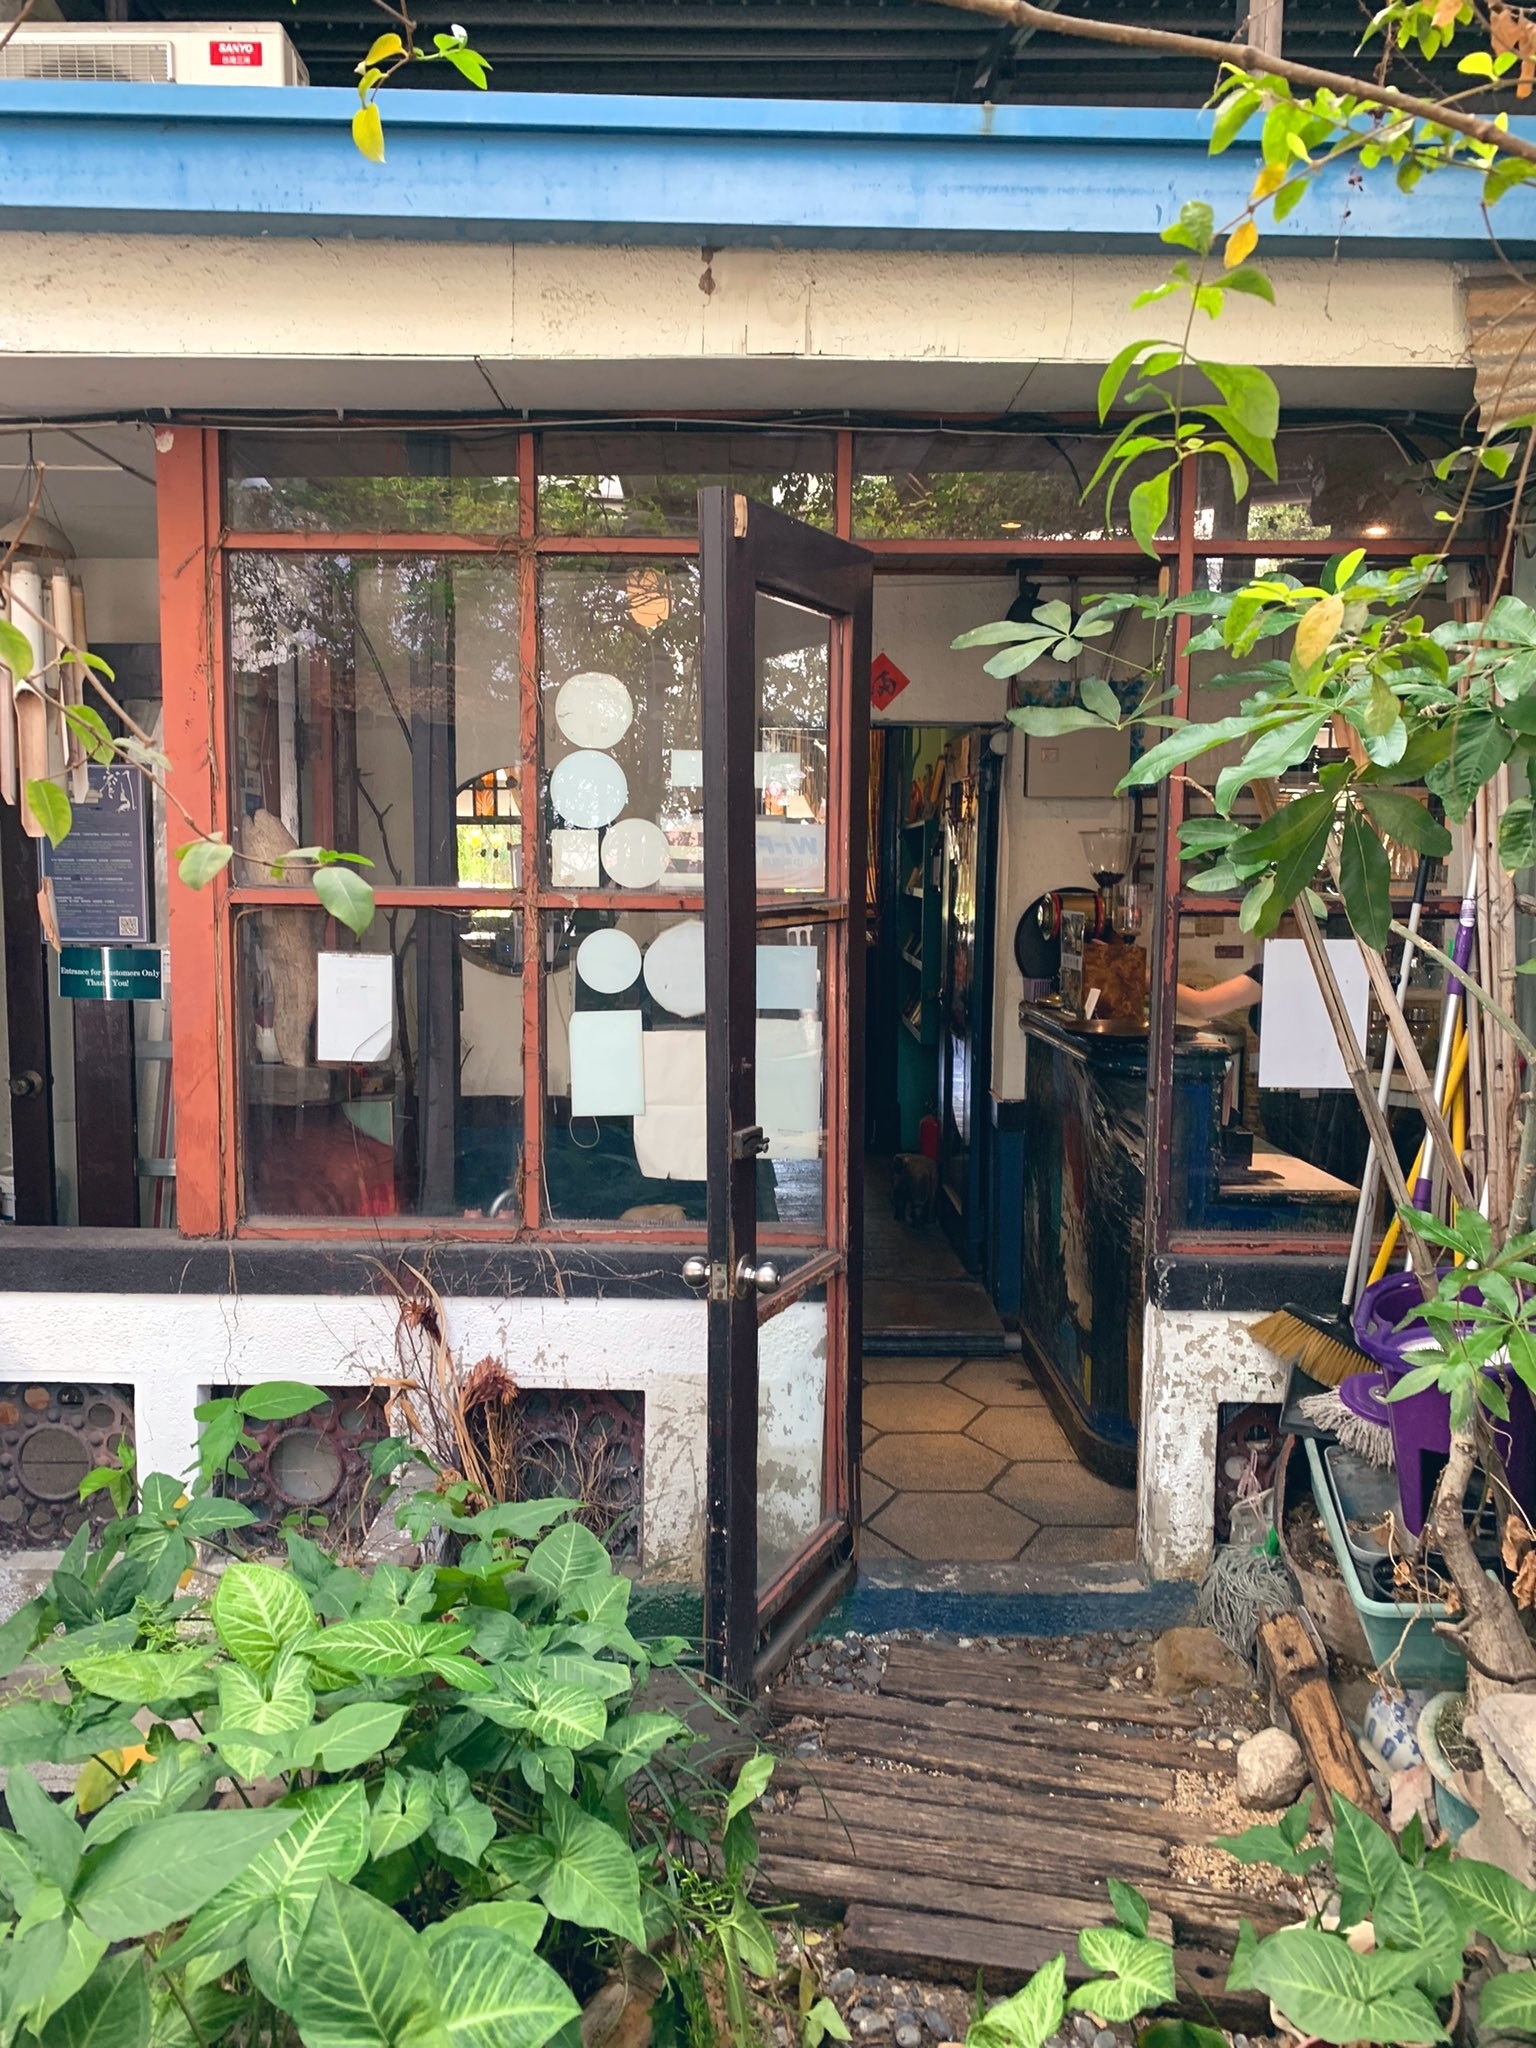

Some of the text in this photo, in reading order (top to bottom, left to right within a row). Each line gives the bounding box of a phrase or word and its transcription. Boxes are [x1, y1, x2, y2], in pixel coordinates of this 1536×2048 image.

[218, 43, 254, 54] SANYO
[60, 966, 89, 976] Entrance
[90, 968, 102, 976] for
[141, 969, 160, 979] Only
[85, 978, 130, 987] Than You!
